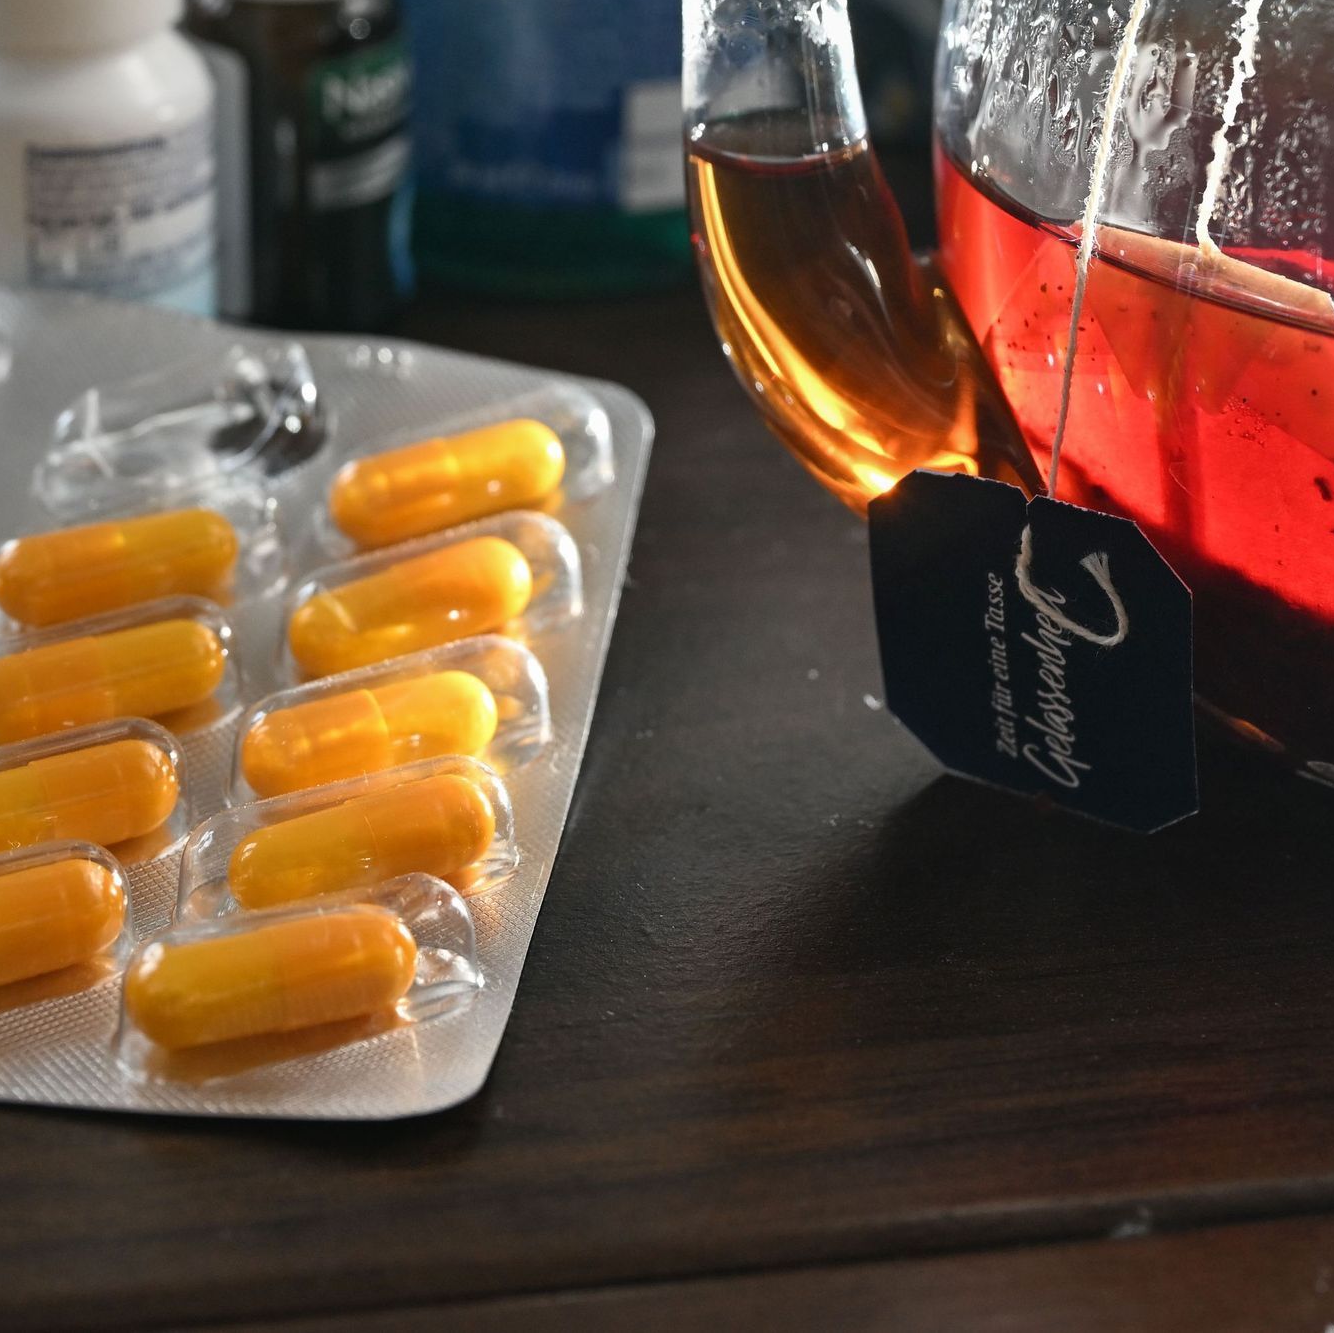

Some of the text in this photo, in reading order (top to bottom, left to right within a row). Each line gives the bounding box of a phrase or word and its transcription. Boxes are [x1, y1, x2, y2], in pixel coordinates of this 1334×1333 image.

[984, 572, 1019, 759] Zeit für eine Tasse
[1020, 585, 1092, 788] Gelassenhet
